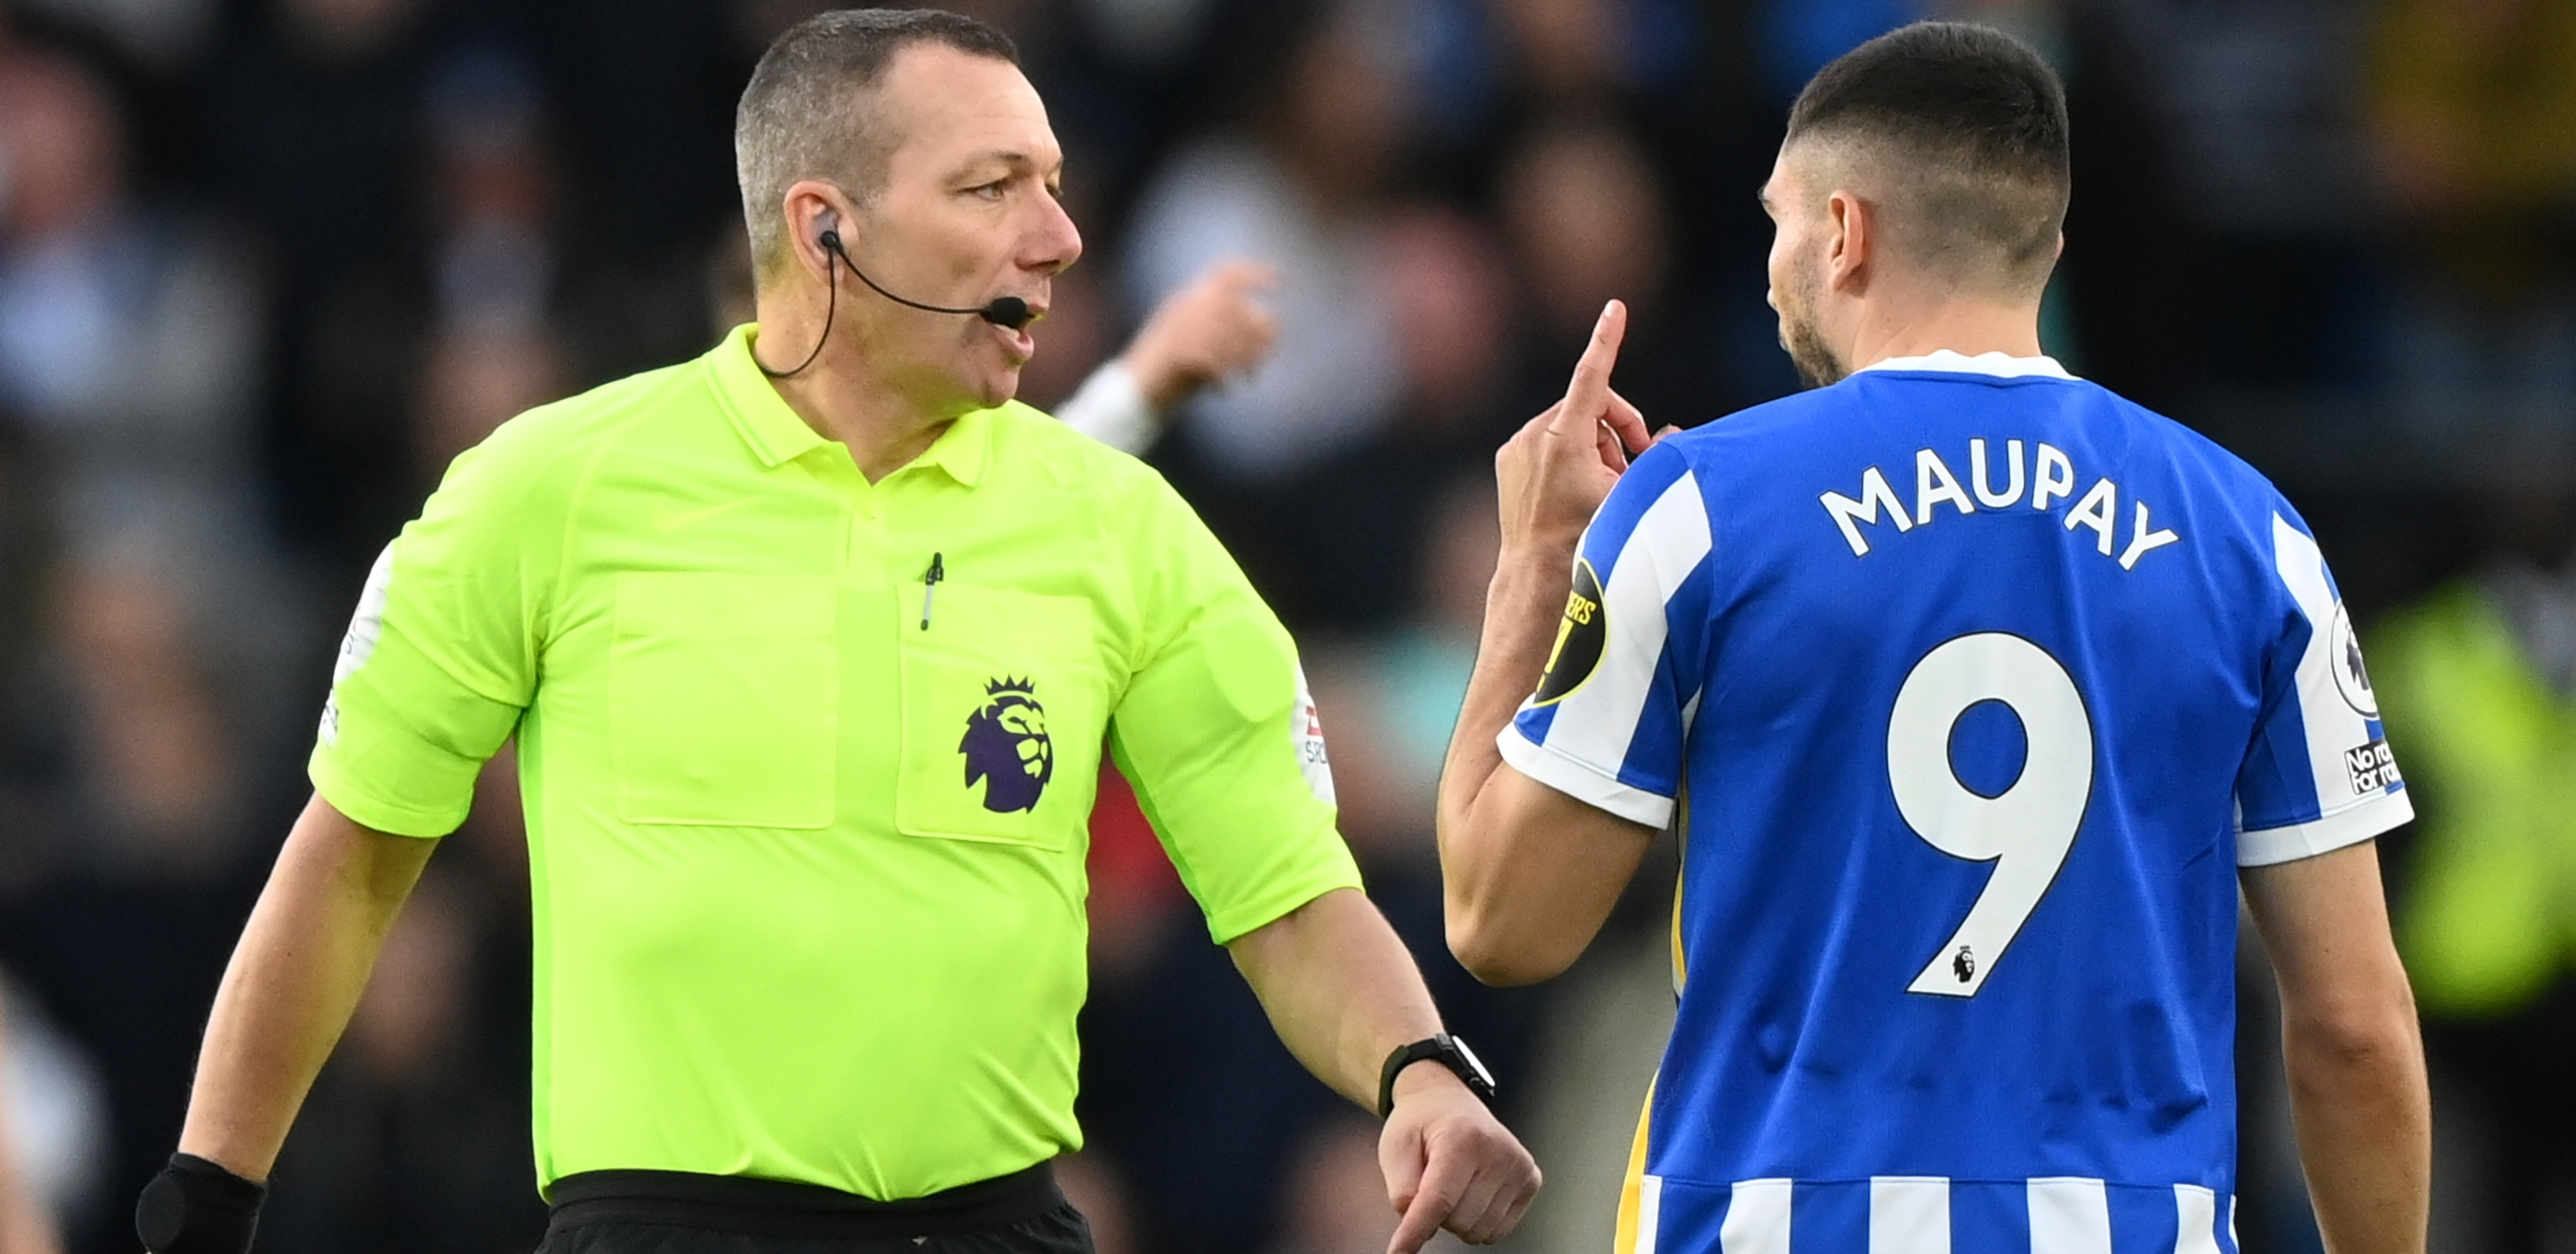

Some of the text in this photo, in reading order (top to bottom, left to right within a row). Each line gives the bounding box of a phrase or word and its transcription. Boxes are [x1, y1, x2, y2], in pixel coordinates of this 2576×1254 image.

[1819, 437, 2180, 572] MAUPAY
[2345, 743, 2393, 775] No ro
[2351, 769, 2378, 794] for
[1885, 630, 2094, 998] 9
